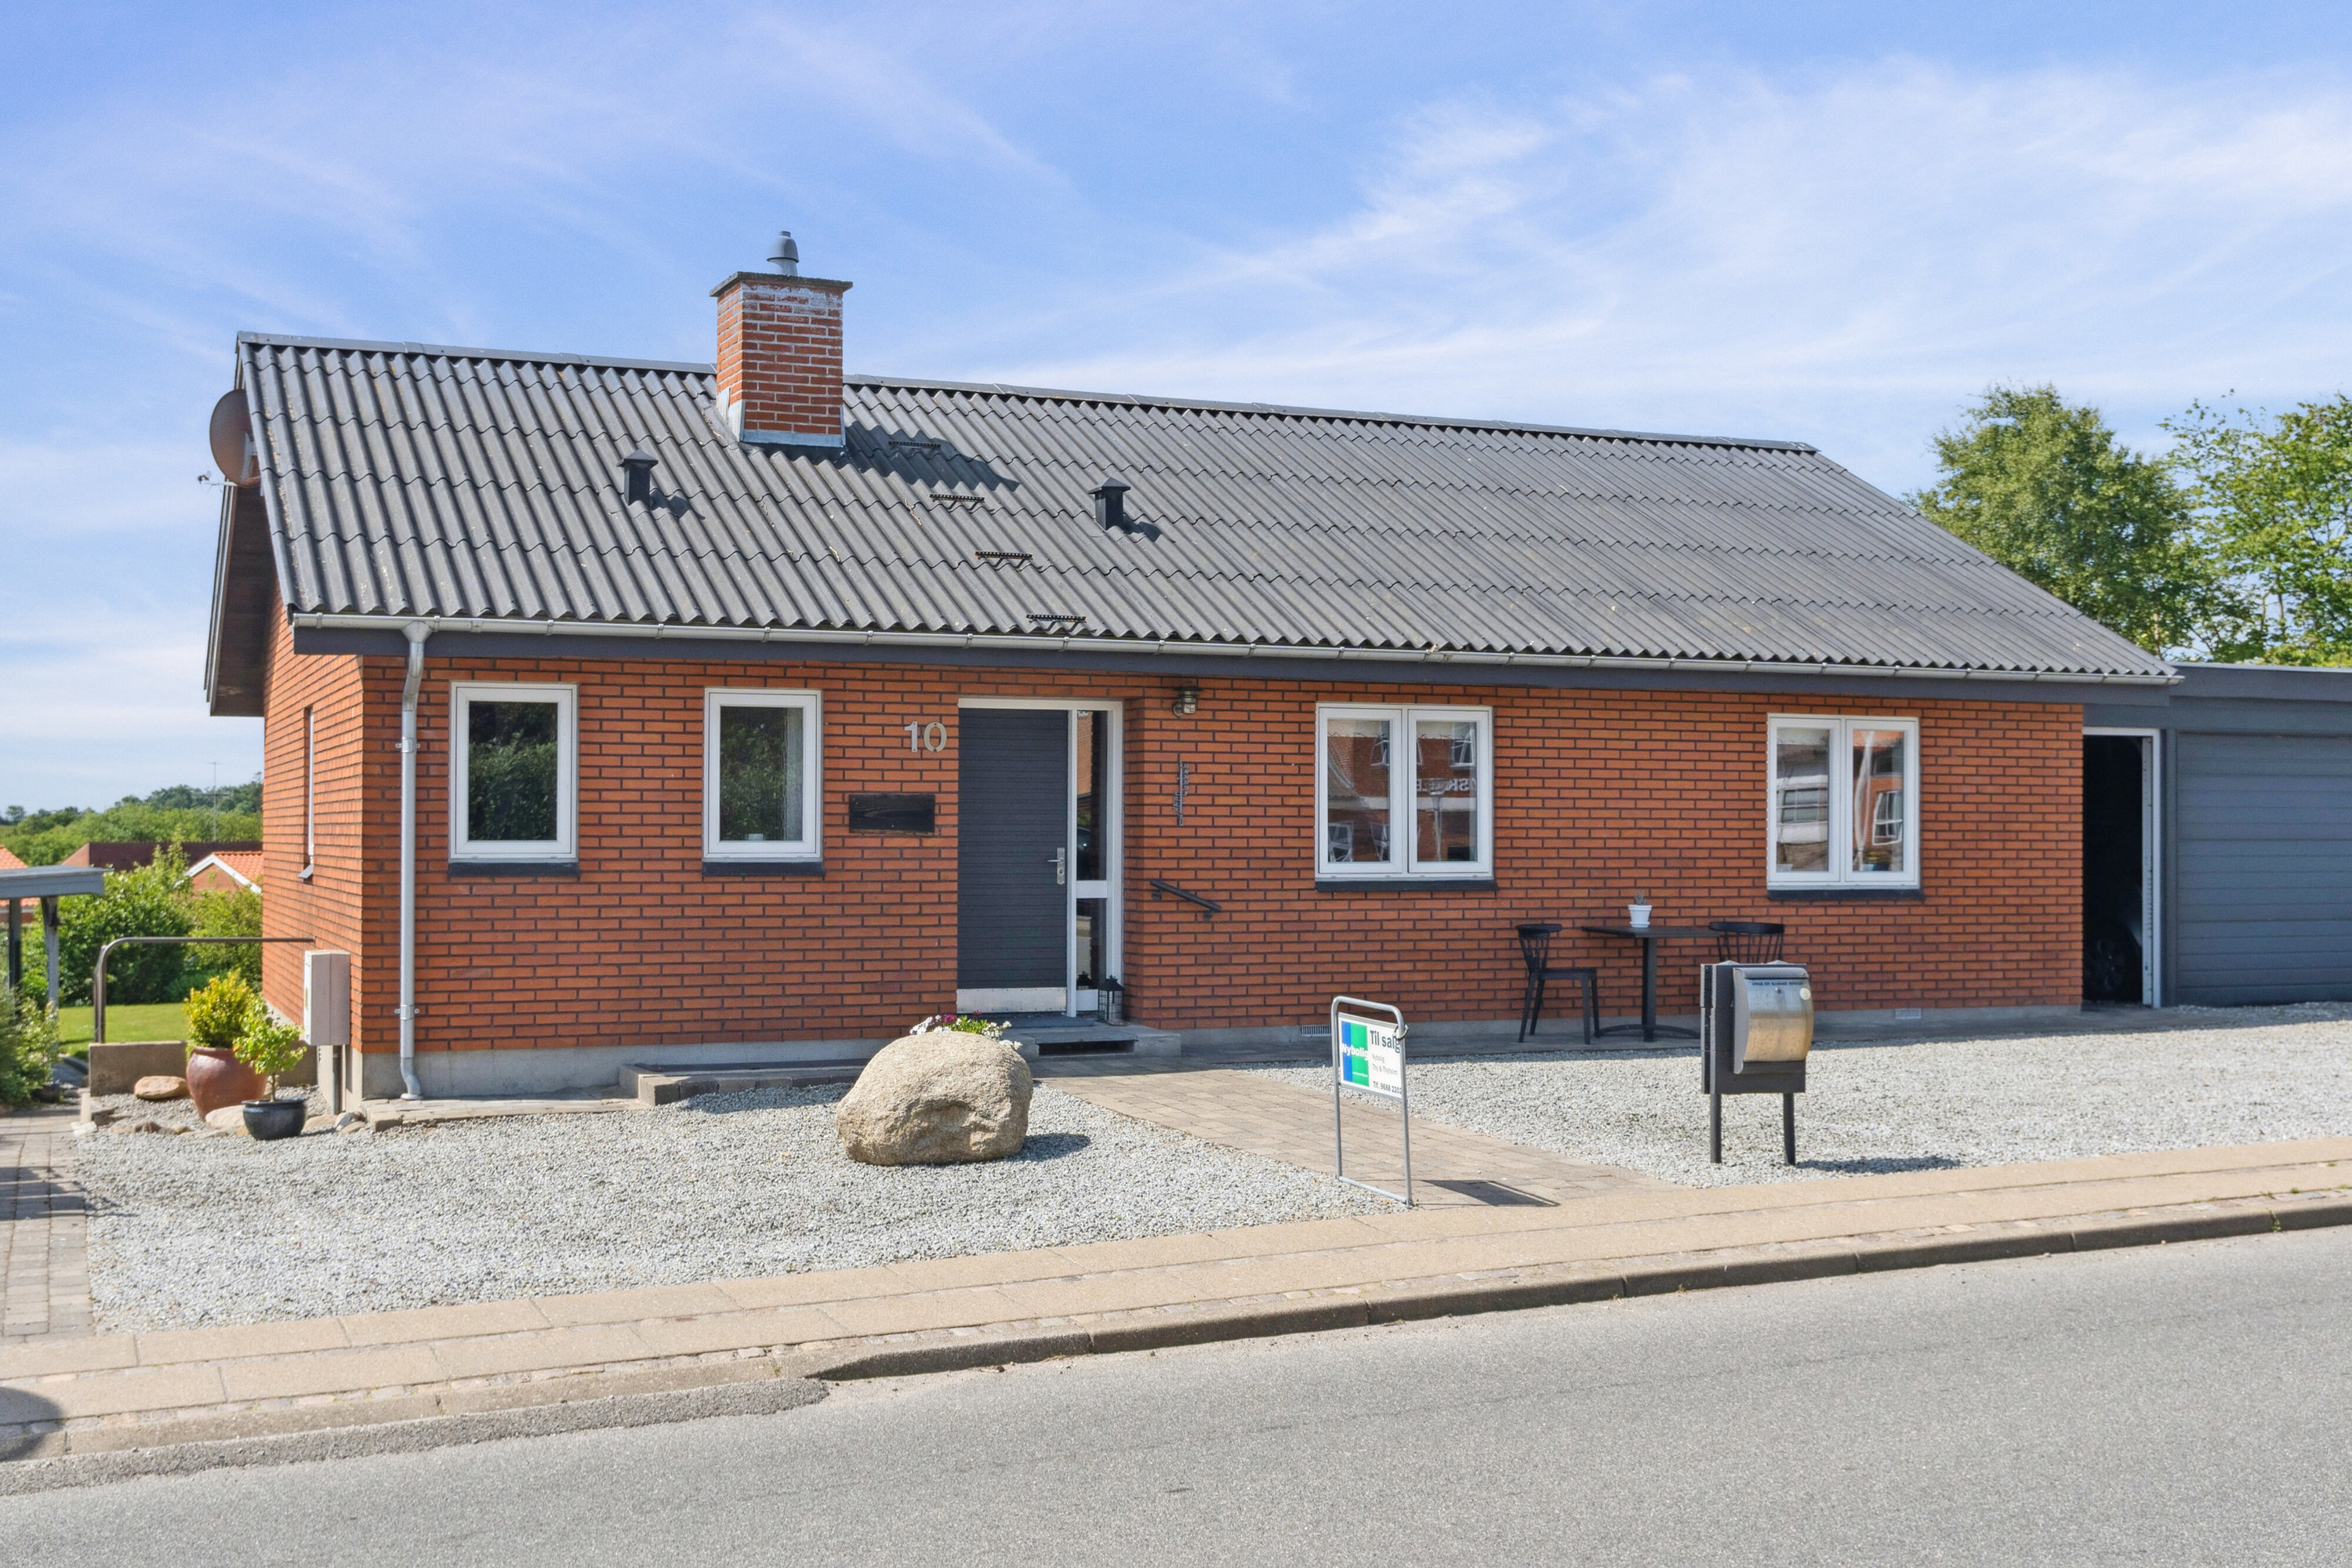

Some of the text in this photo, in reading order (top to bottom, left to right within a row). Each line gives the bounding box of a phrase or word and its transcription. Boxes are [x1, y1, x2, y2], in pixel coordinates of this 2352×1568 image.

[904, 720, 947, 753] 10
[1341, 1043, 1368, 1061] Nybolig
[1370, 1029, 1400, 1054] Til salg
